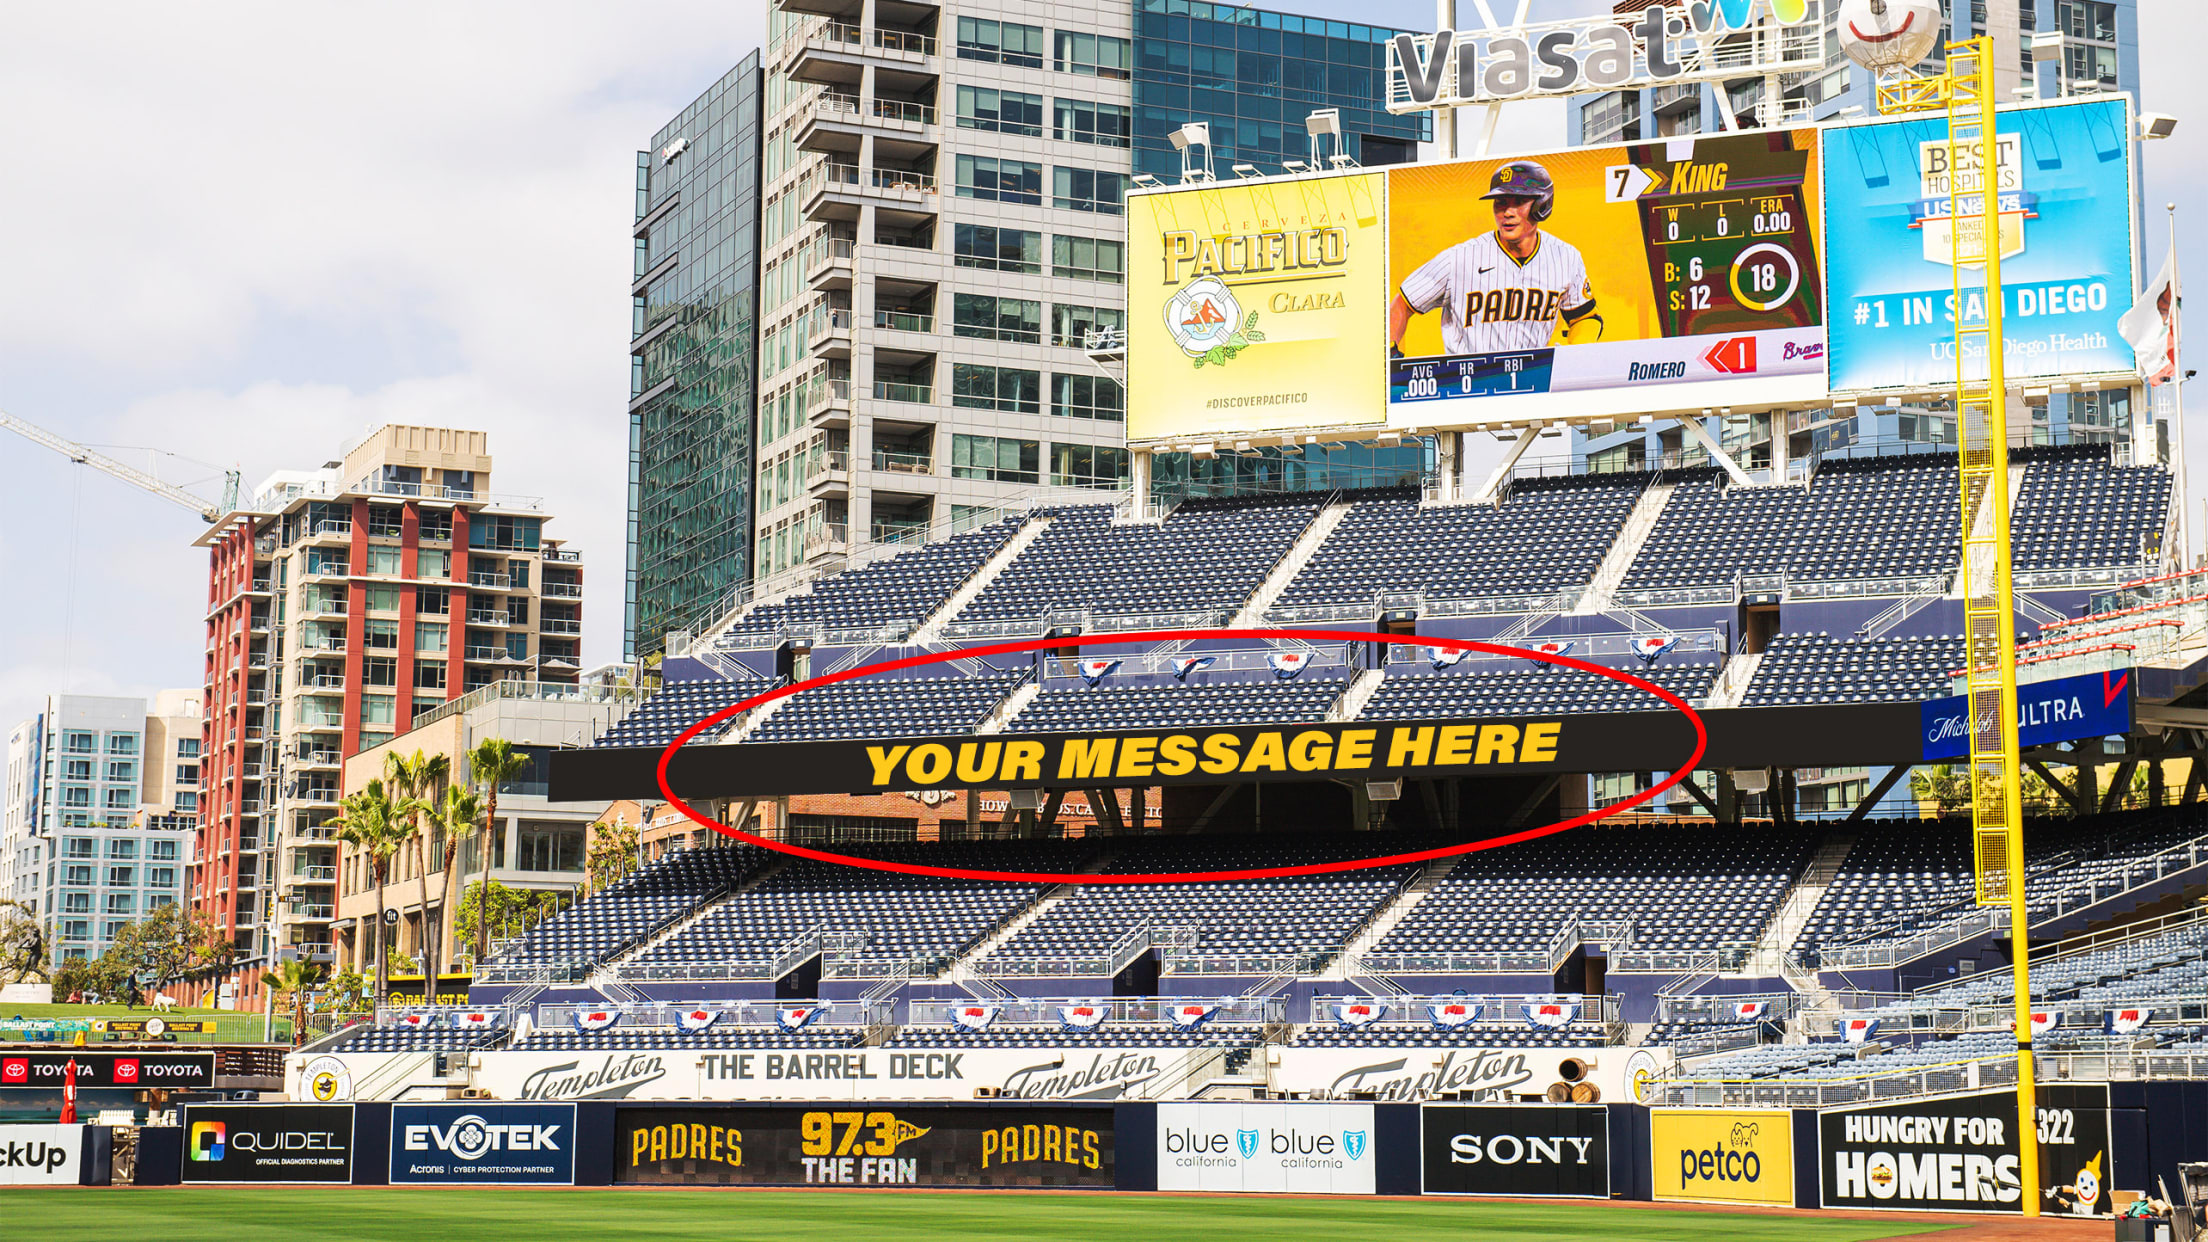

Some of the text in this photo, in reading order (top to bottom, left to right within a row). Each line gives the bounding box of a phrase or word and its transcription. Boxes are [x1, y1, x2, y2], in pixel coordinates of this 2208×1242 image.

[1395, 6, 1682, 103] Viasat
[1927, 141, 2013, 174] BEST
[1614, 169, 1630, 198] 7
[1928, 170, 2015, 194] HOSPITLS
[1667, 208, 1679, 221] W
[1719, 204, 1726, 217] L
[1760, 198, 1783, 213] ERA
[1222, 212, 1347, 232] CERVEZA
[1667, 222, 1679, 240] 0
[1716, 217, 1728, 236] 0
[1753, 211, 1791, 233] 0.00
[1163, 226, 1349, 285] PACIFICO
[1664, 257, 1704, 282] B: 6
[1751, 263, 1777, 292] 18
[1268, 291, 1346, 314] CLARA
[1465, 288, 1564, 328] PADRE
[1669, 285, 1712, 311] S: 12
[1854, 283, 2107, 328] #1 IN SA DIEGO
[2048, 332, 2108, 352] Health
[1504, 358, 1523, 372] RBI
[1738, 342, 1746, 369] 1
[1411, 364, 1433, 379] AVG
[1459, 362, 1475, 376] HR
[1509, 372, 1517, 390] 1
[1628, 361, 1686, 381] ROMERO
[1404, 377, 1438, 397] .000
[1461, 375, 1472, 393] 0
[1206, 392, 1308, 409] #DISCOVERPACIFICO
[1928, 710, 1995, 743] Michlob
[405, 993, 455, 1006] BALAST
[33, 1064, 94, 1077] TOYTA
[144, 1064, 203, 1077] TOYOTA
[520, 1053, 666, 1100] Templeton
[703, 1053, 964, 1080] THE BARREL DECK
[1003, 1052, 1161, 1099] Templeton
[405, 1114, 561, 1160] EVOTEK
[801, 1111, 896, 1156] 97.3
[1845, 1115, 2005, 1146] HUNGRY FOR
[2037, 1109, 2075, 1145] 322
[232, 1131, 346, 1153] QUIDEL
[632, 1123, 743, 1167] PADRES
[981, 1124, 1100, 1170] PADRES
[1166, 1127, 1229, 1153] blue
[1271, 1128, 1335, 1154] blue
[1450, 1134, 1593, 1165] SONY
[255, 1158, 345, 1166] OFFICIAL DIAGNOSTICS PARTNER
[409, 1164, 555, 1174] Acronis CYBER PROTECTION PARTNER
[801, 1157, 917, 1184] THE FAN
[1175, 1155, 1237, 1168] california
[1281, 1157, 1343, 1169] california
[1680, 1141, 1761, 1190] petco
[1835, 1151, 2022, 1203] HOMERS
